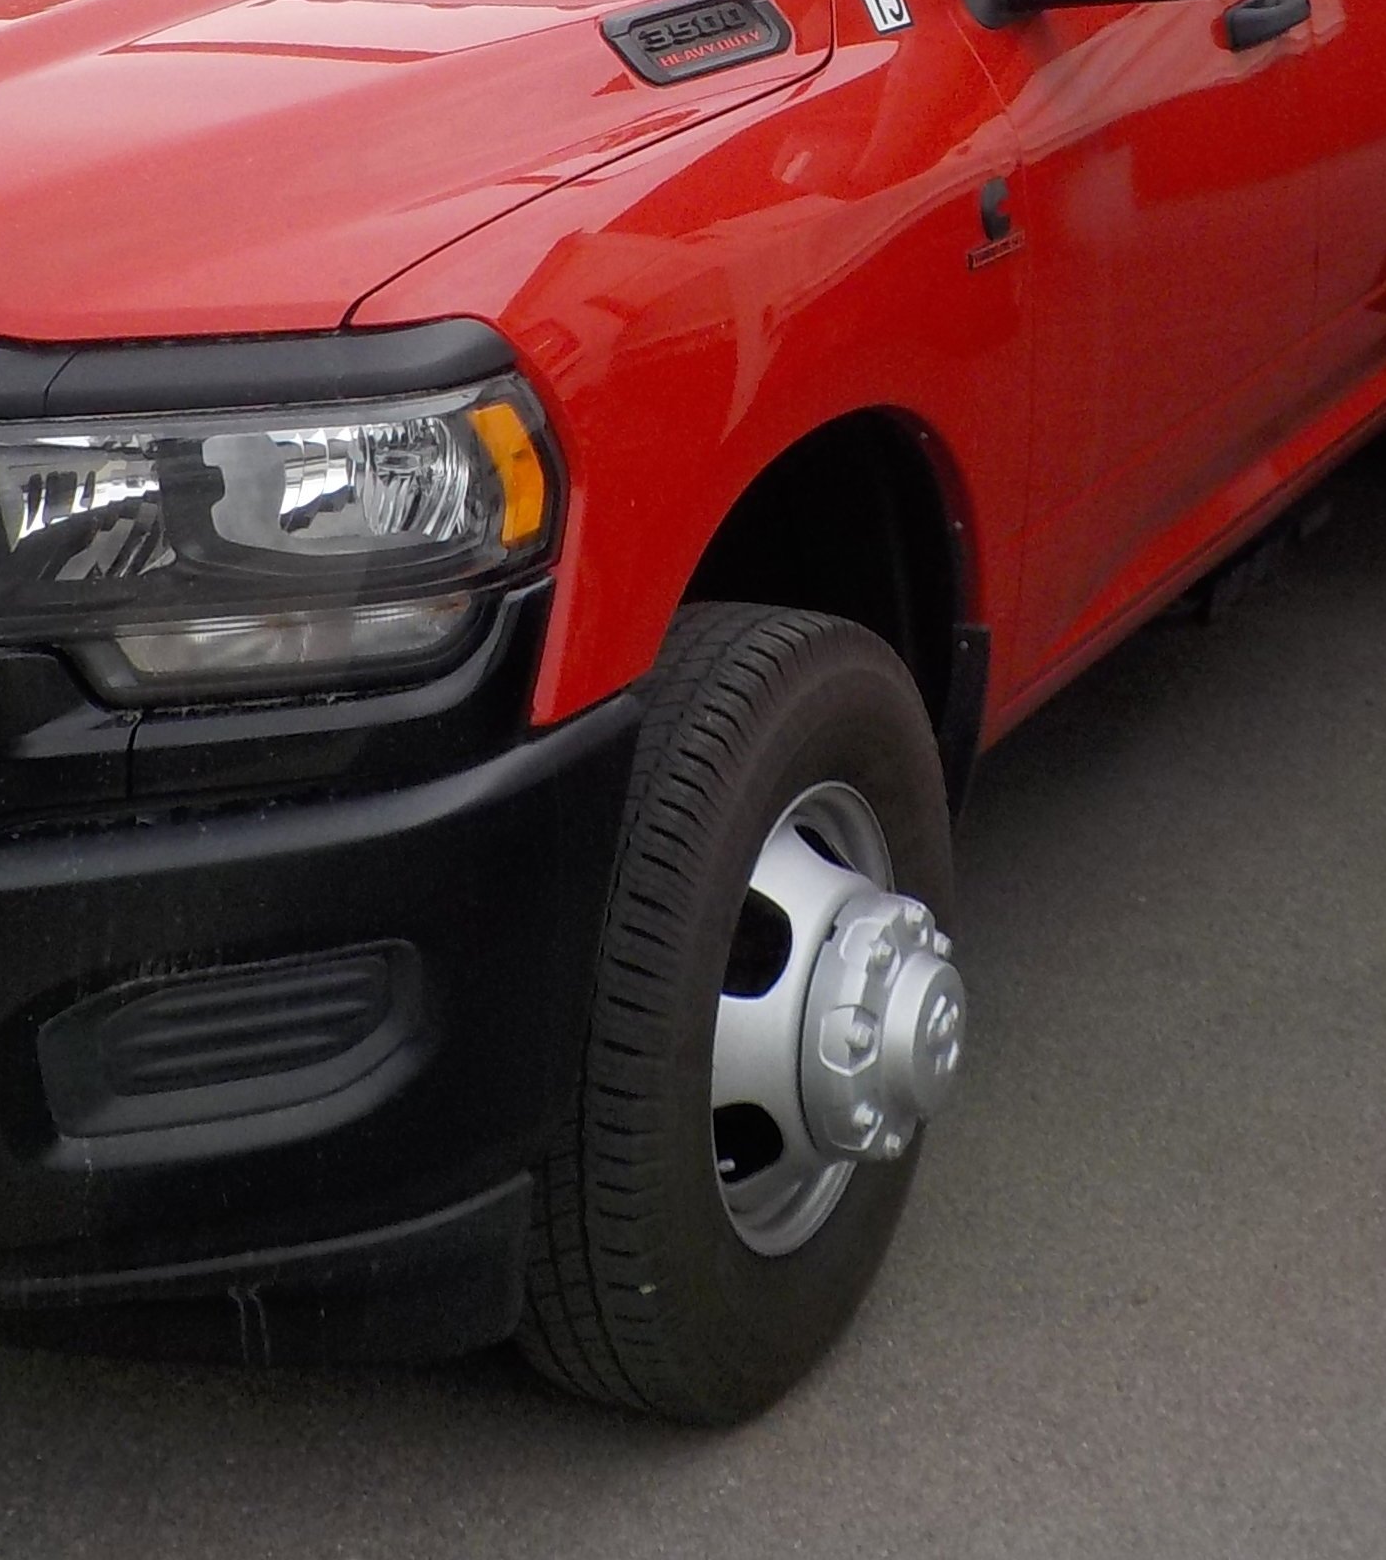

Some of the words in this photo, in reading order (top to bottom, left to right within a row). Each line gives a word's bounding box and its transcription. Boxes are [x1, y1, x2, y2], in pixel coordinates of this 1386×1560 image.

[638, 7, 746, 52] 3500
[660, 43, 715, 67] HEAVY
[716, 30, 760, 51] DUTY
